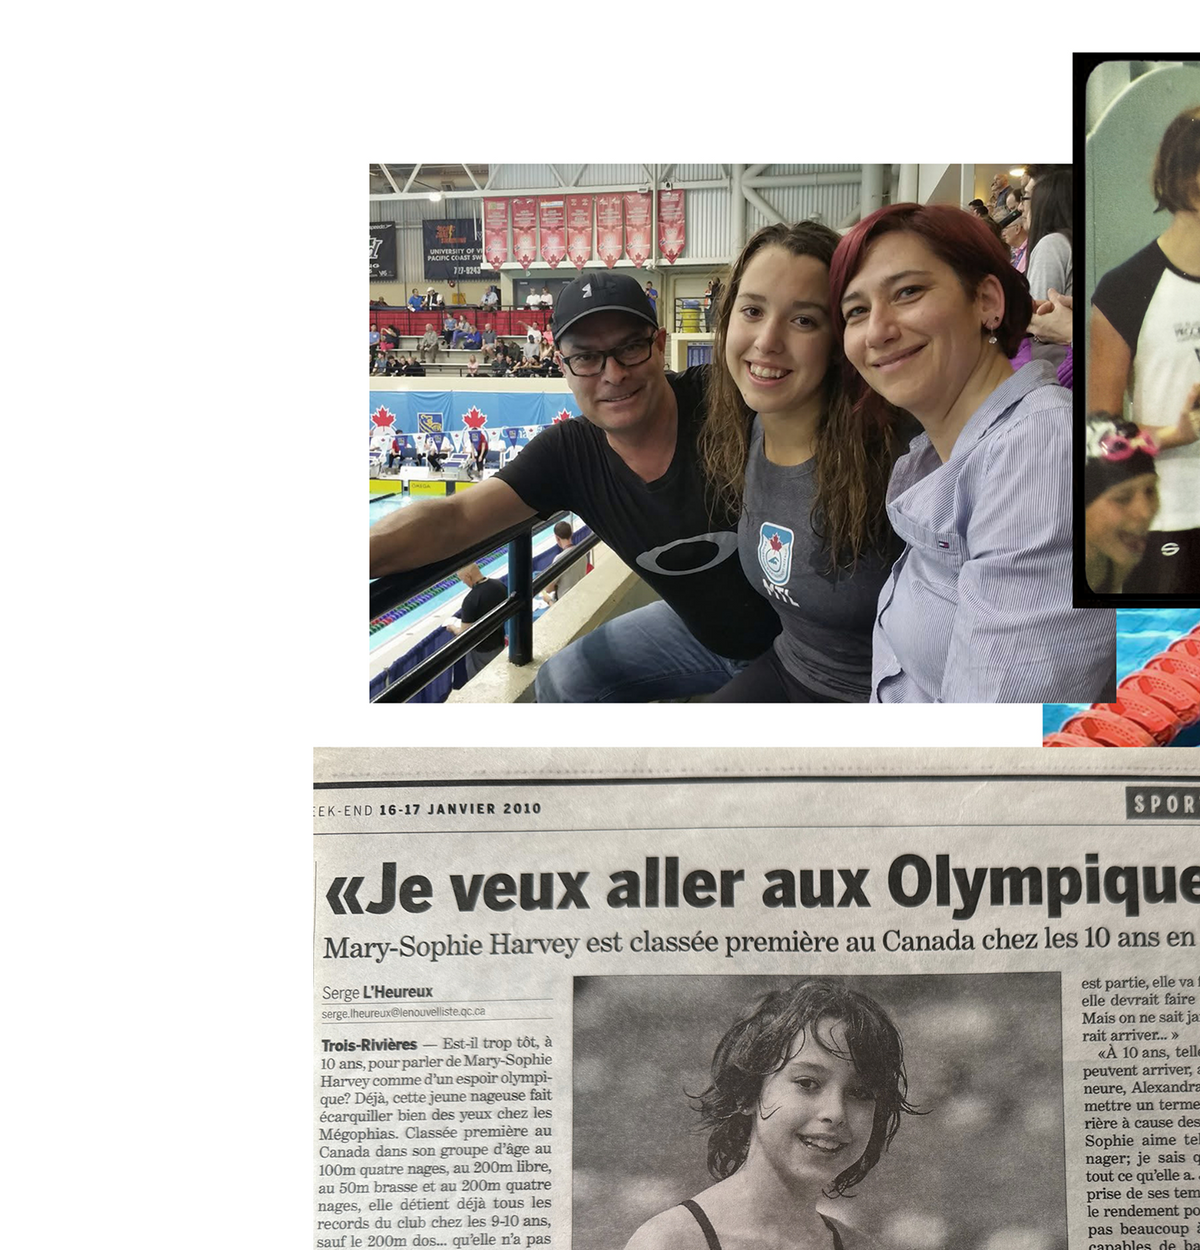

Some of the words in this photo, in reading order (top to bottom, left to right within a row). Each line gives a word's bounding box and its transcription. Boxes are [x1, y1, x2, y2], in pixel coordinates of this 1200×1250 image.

[762, 578, 801, 608] MTL
[379, 803, 421, 816] 16-17
[427, 802, 496, 816] JANVIER
[503, 802, 542, 815] 2010
[449, 871, 591, 912] veux
[606, 855, 745, 909] aller
[762, 868, 872, 908] aux
[322, 933, 483, 964] Mary-Sophie
[489, 932, 581, 960] Harvey
[585, 931, 624, 953] est
[629, 929, 719, 953] classée
[724, 929, 839, 959] première
[845, 935, 876, 953] au
[882, 927, 976, 952] Canada
[981, 926, 1038, 951] chez
[1044, 925, 1079, 949] les
[1084, 925, 1111, 949] 10
[1117, 930, 1161, 948] ans
[1166, 930, 1196, 947] en
[1080, 976, 1103, 990] est
[1104, 975, 1150, 993] partie,
[1151, 974, 1176, 989] elle
[1177, 977, 1195, 988] va
[321, 985, 360, 1003] Serge
[1081, 993, 1106, 1008] elle
[1109, 992, 1160, 1007] devrait
[1163, 991, 1196, 1006] faire
[321, 1006, 486, 1022] serge.lheureux@lenouvelliste.qc.ca
[320, 1037, 418, 1053] Trois-Rivières
[442, 1036, 478, 1050] Est-il
[482, 1038, 512, 1052] trop
[516, 1035, 540, 1050] tôt,
[544, 1034, 553, 1048] à
[320, 1057, 336, 1070] 10
[338, 1059, 366, 1072] ans,
[367, 1058, 401, 1073] pour
[401, 1054, 444, 1072] parler
[444, 1054, 462, 1068] de
[462, 1052, 553, 1070] Mary-Sophie
[319, 1074, 371, 1090] Harvey
[371, 1076, 422, 1087] comme
[455, 1071, 499, 1088] espoir
[500, 1069, 553, 1087] olympi-
[319, 1091, 351, 1109] que?
[354, 1091, 389, 1108] Déjà,
[392, 1091, 427, 1104] cette
[427, 1089, 467, 1106] jeune
[469, 1091, 526, 1105] nageuse
[529, 1087, 553, 1101] fait
[318, 1126, 399, 1144] Mégophias.
[404, 1125, 458, 1140] Classée
[462, 1124, 529, 1142] première
[534, 1126, 553, 1137] au
[318, 1144, 371, 1159] Canada
[374, 1144, 408, 1158] dans
[411, 1146, 436, 1157] son
[439, 1145, 489, 1160] groupe
[534, 1144, 552, 1155] au
